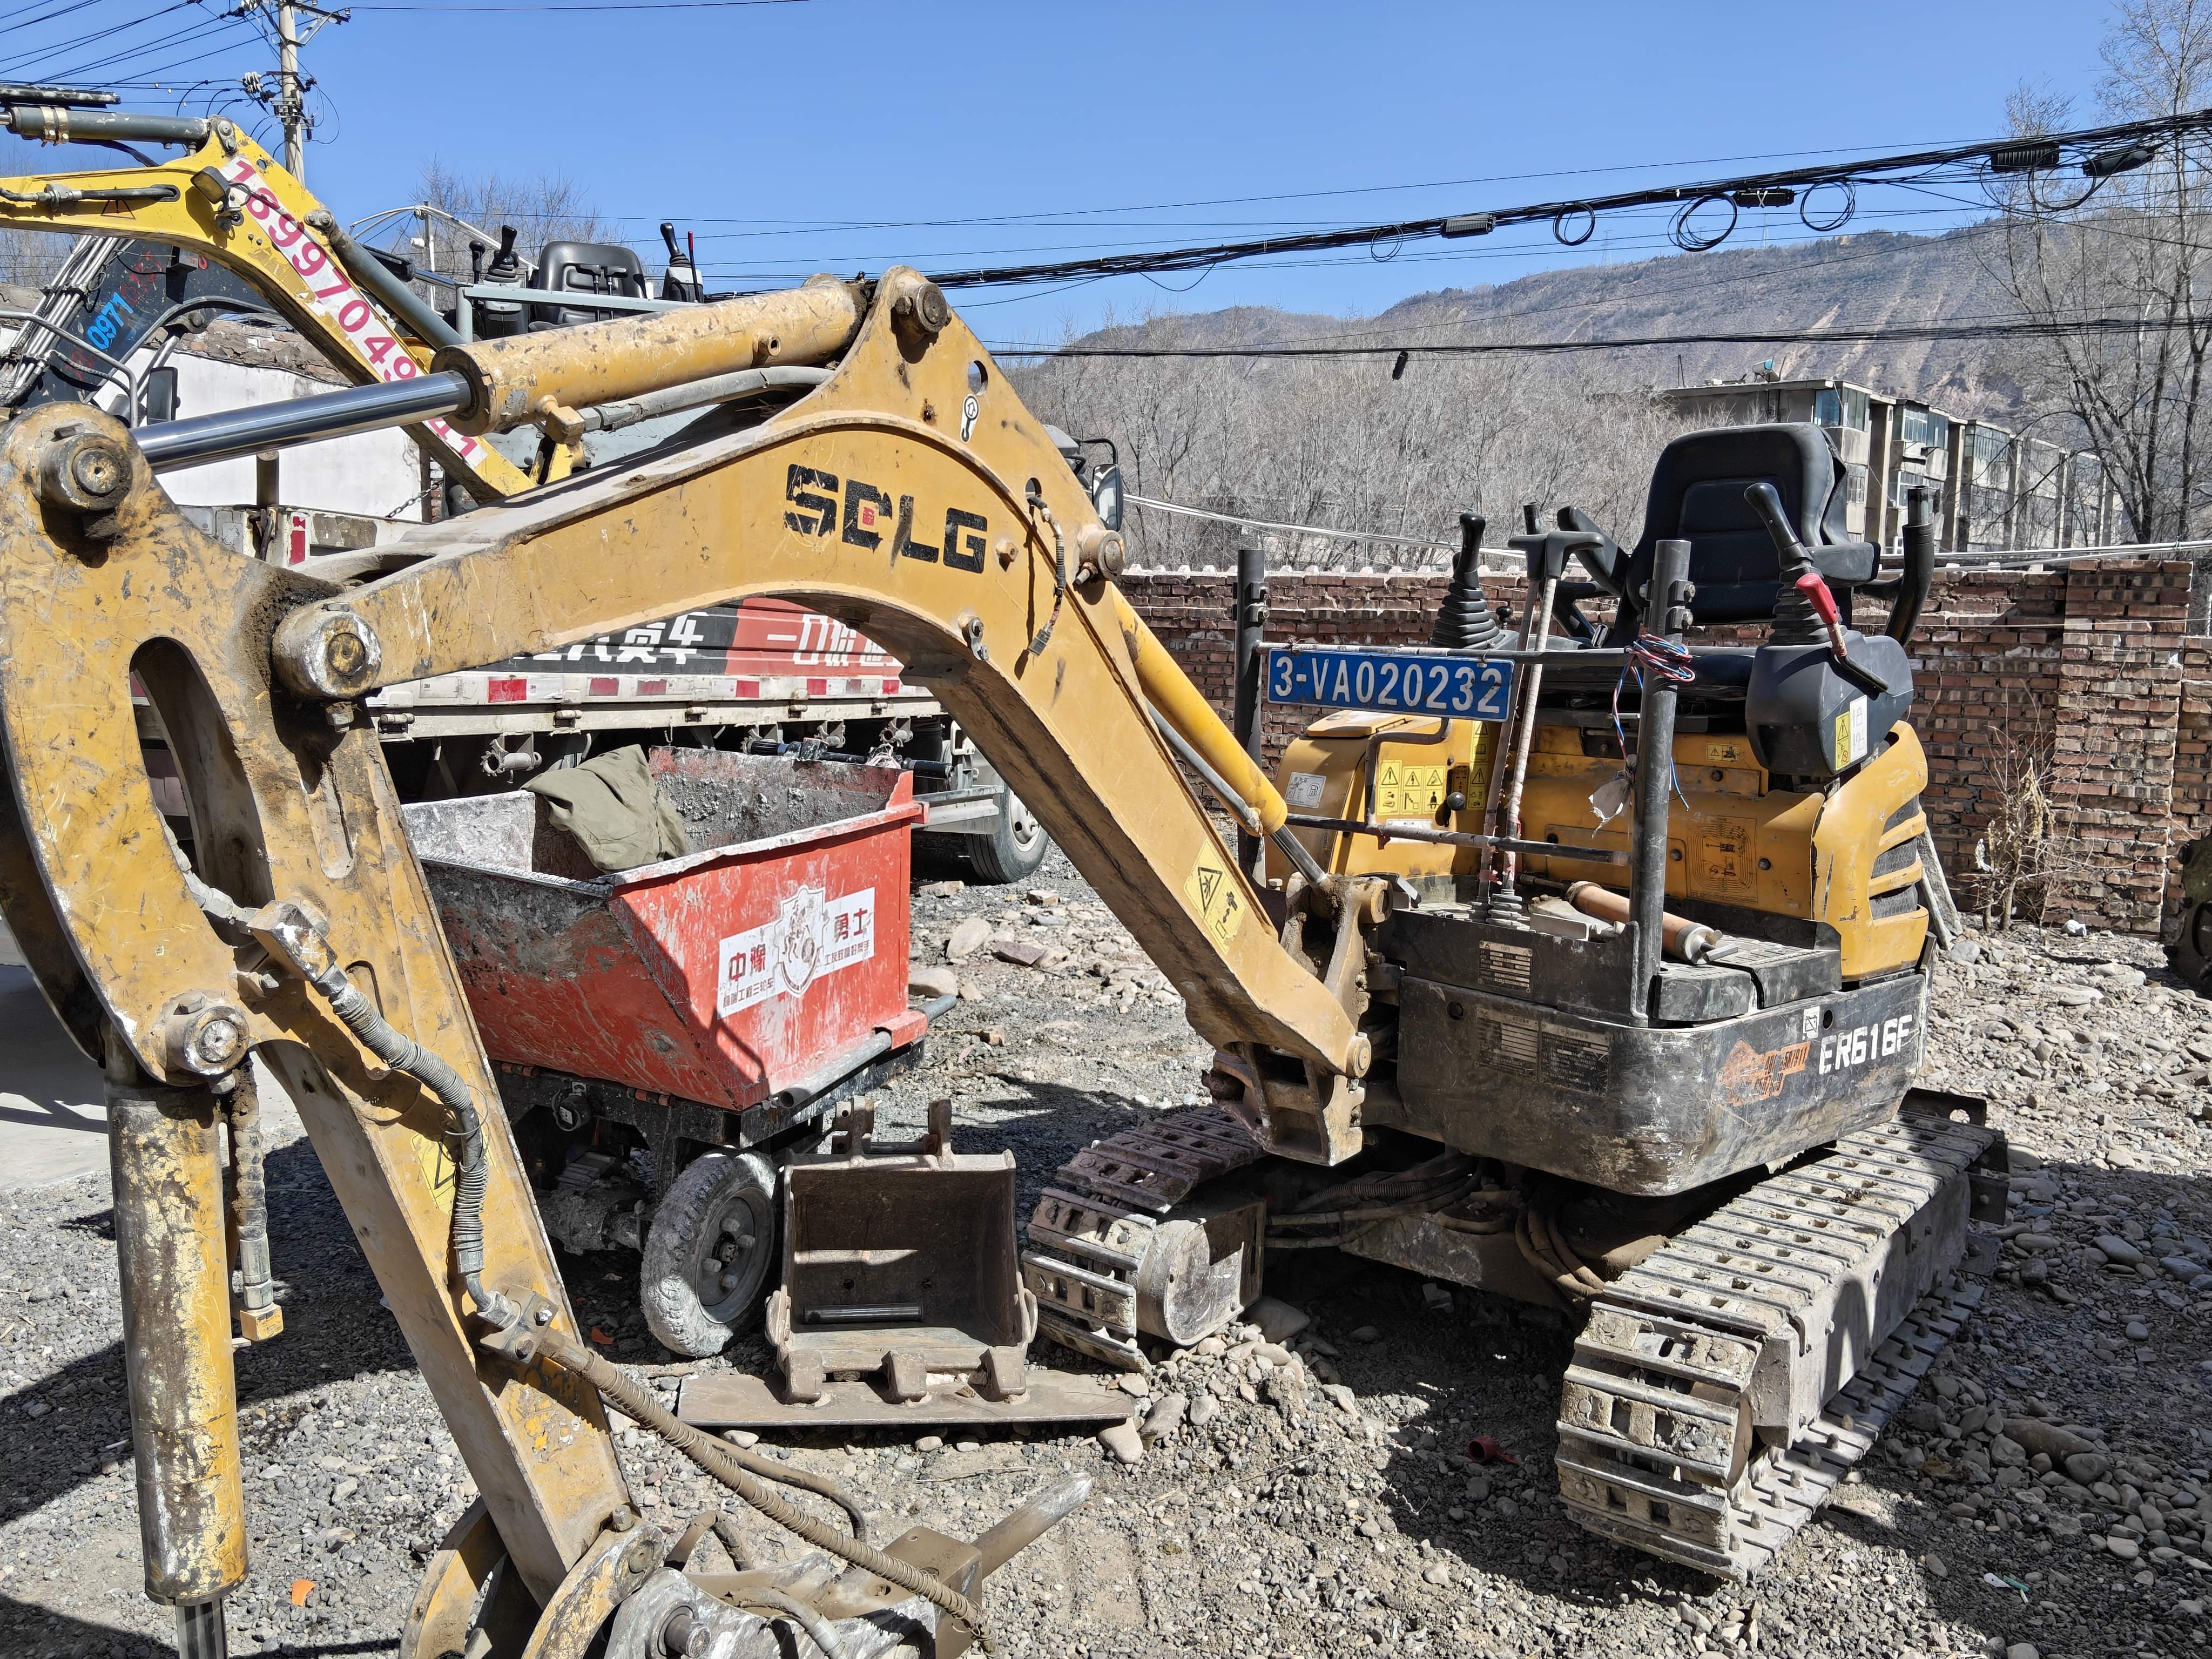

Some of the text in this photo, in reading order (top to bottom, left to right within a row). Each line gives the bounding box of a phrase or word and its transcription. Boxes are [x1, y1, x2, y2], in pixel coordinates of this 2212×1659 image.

[87, 292, 133, 350] 0971
[1274, 656, 1502, 713] 3-VA020232
[834, 908, 868, 943] 勇士
[729, 943, 766, 981] 中豫
[1818, 1014, 1913, 1075] ER616F
